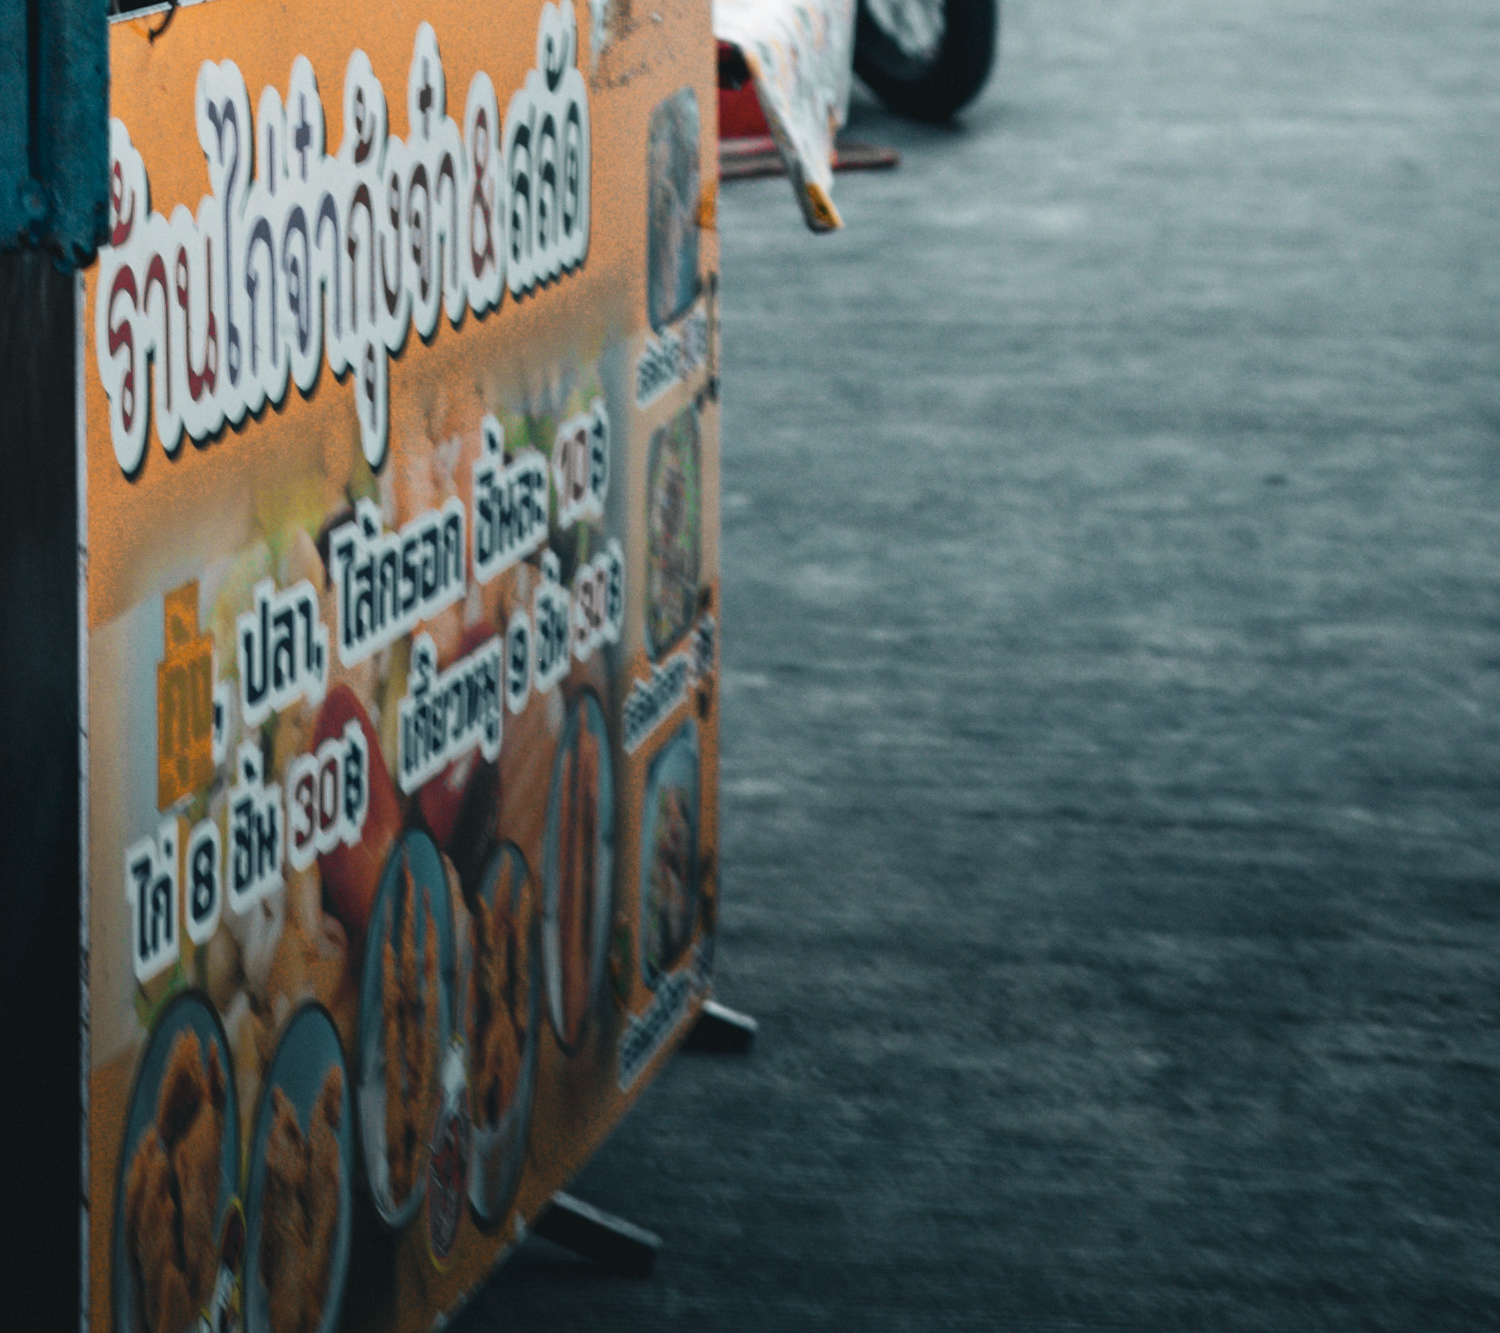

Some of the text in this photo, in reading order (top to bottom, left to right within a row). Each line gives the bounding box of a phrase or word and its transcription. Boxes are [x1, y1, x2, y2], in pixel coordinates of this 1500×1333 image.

[242, 590, 325, 711] ปลา,
[336, 507, 466, 653] ไส้กรอก
[131, 831, 174, 967] ไก่
[190, 833, 219, 928] 8
